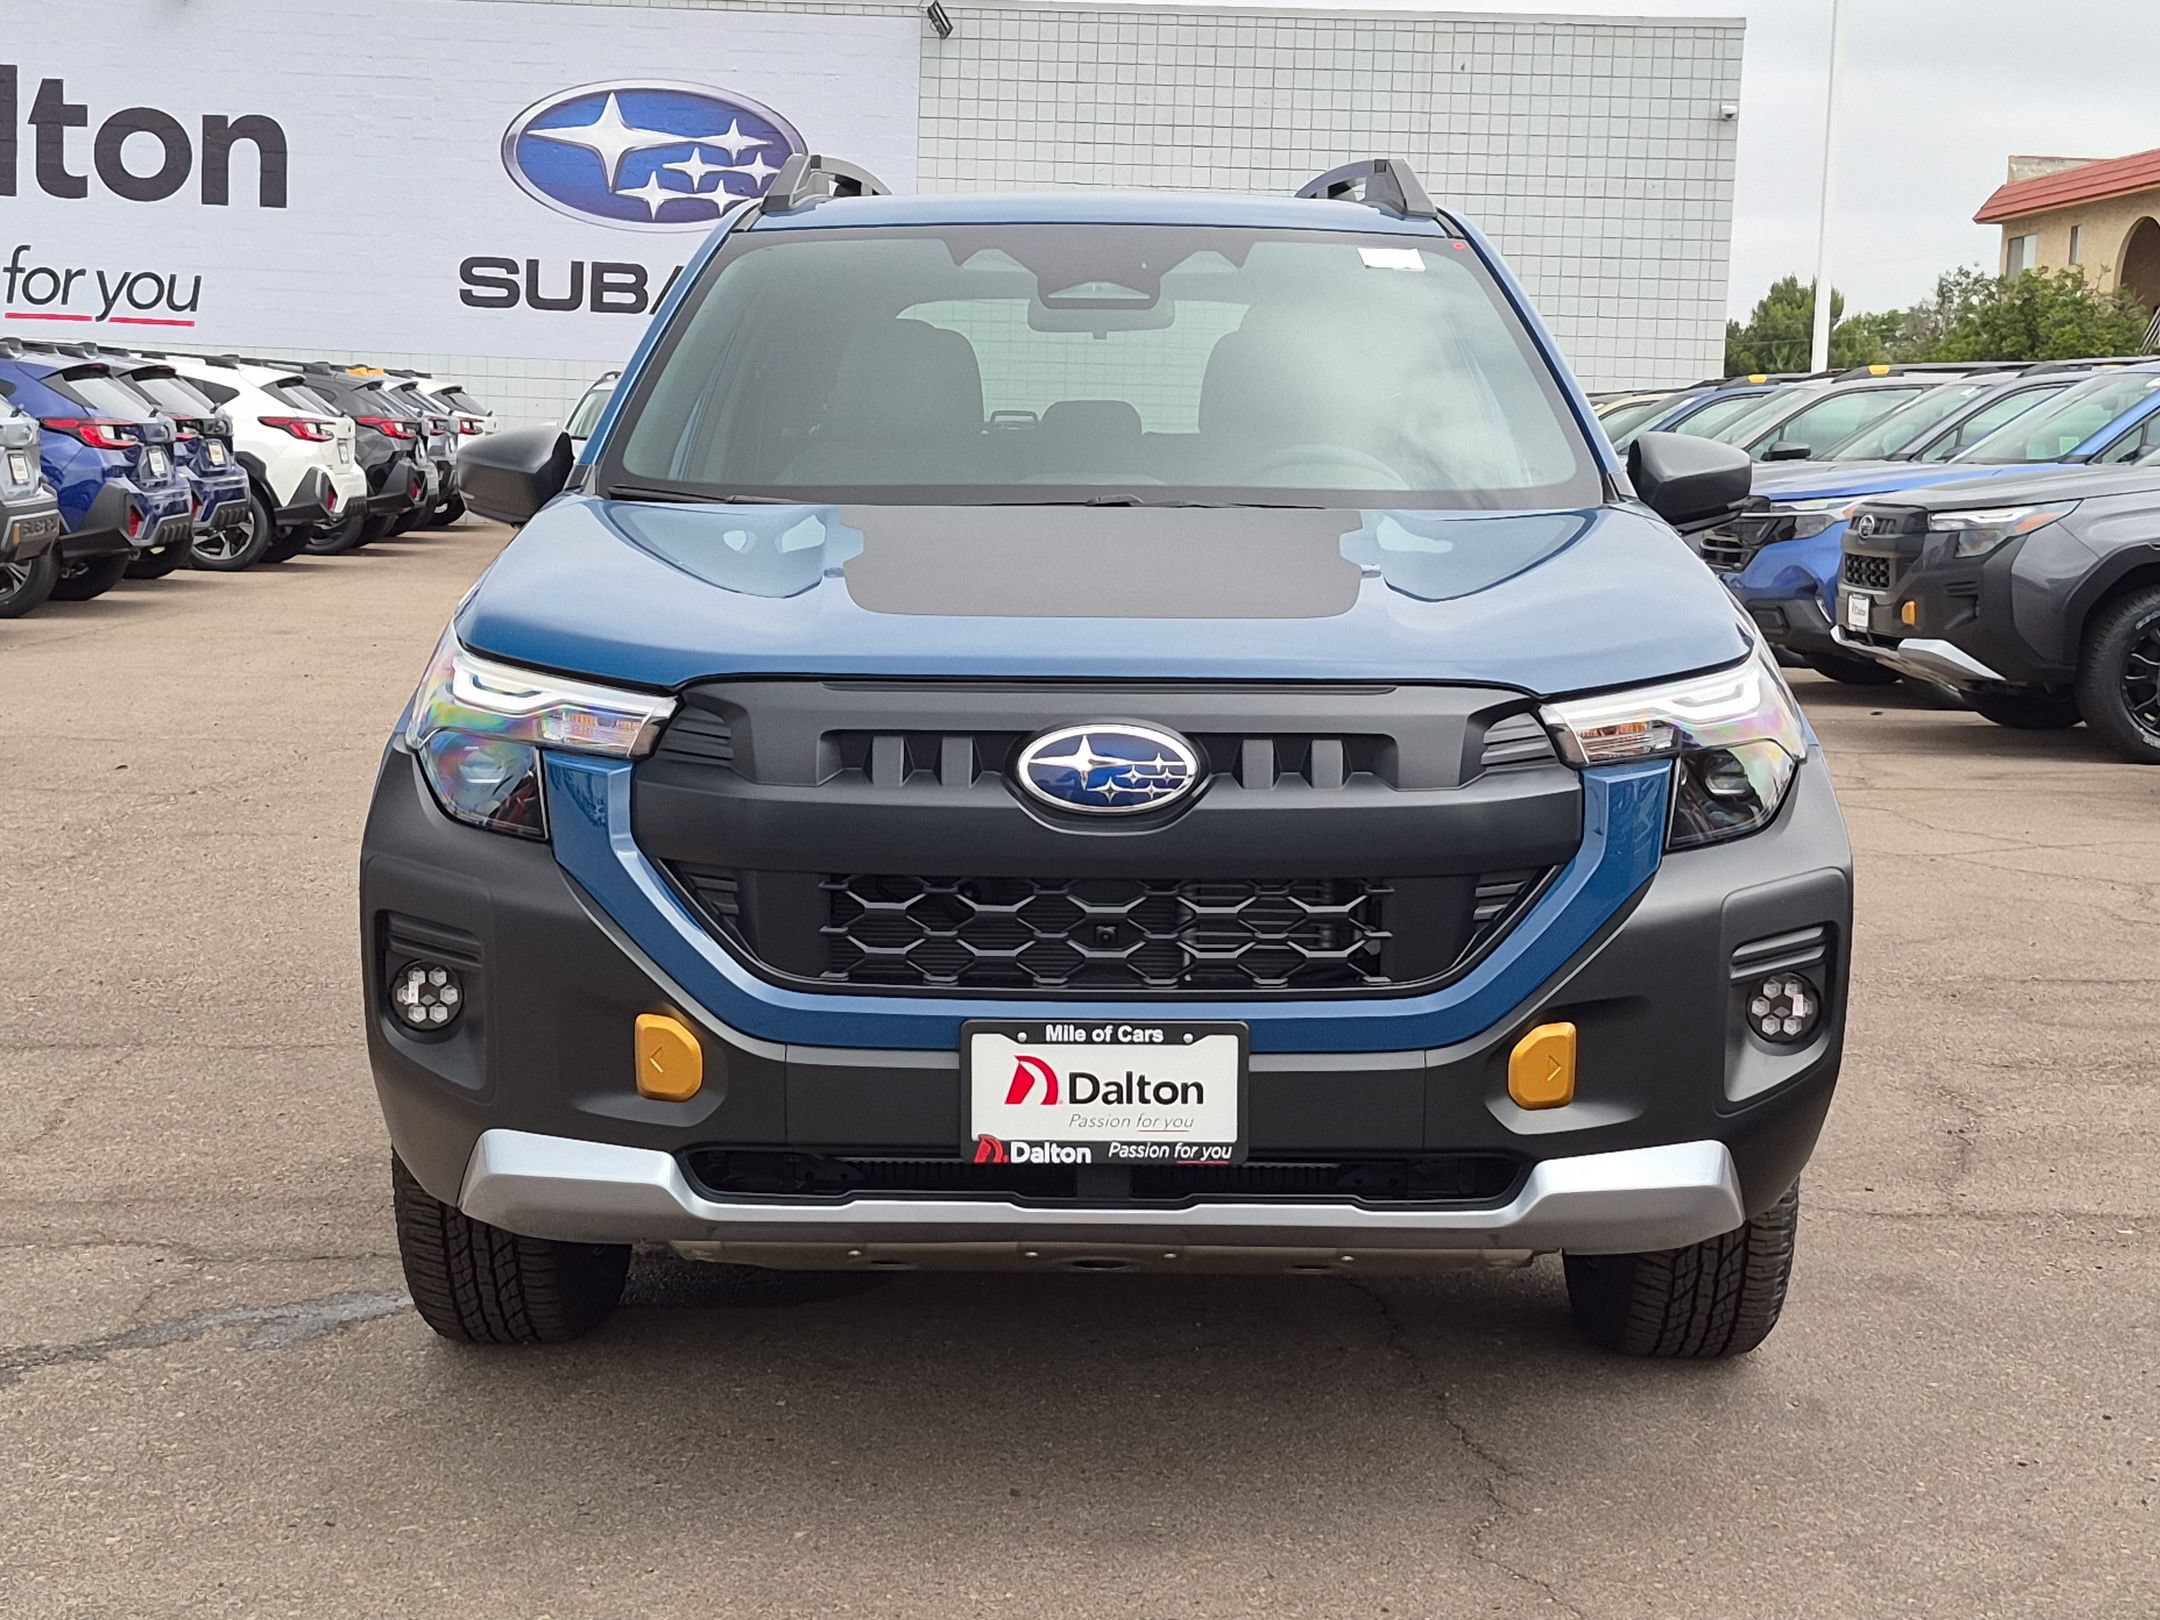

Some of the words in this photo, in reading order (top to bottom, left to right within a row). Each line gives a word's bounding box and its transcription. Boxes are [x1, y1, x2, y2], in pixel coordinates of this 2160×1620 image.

[3, 245, 87, 304] for
[95, 264, 202, 322] you
[459, 256, 684, 315] SUB
[1046, 1025, 1085, 1042] Mile
[1092, 1025, 1113, 1042] of
[1118, 1026, 1164, 1043] Cars
[1068, 1071, 1204, 1105] Dalton
[1068, 1113, 1130, 1128] Passion
[1137, 1113, 1160, 1129] for
[1163, 1118, 1194, 1132] you
[1010, 1142, 1092, 1164] Dalton
[1108, 1142, 1169, 1159] Passion
[1173, 1142, 1198, 1160] for
[1199, 1145, 1232, 1162] you
